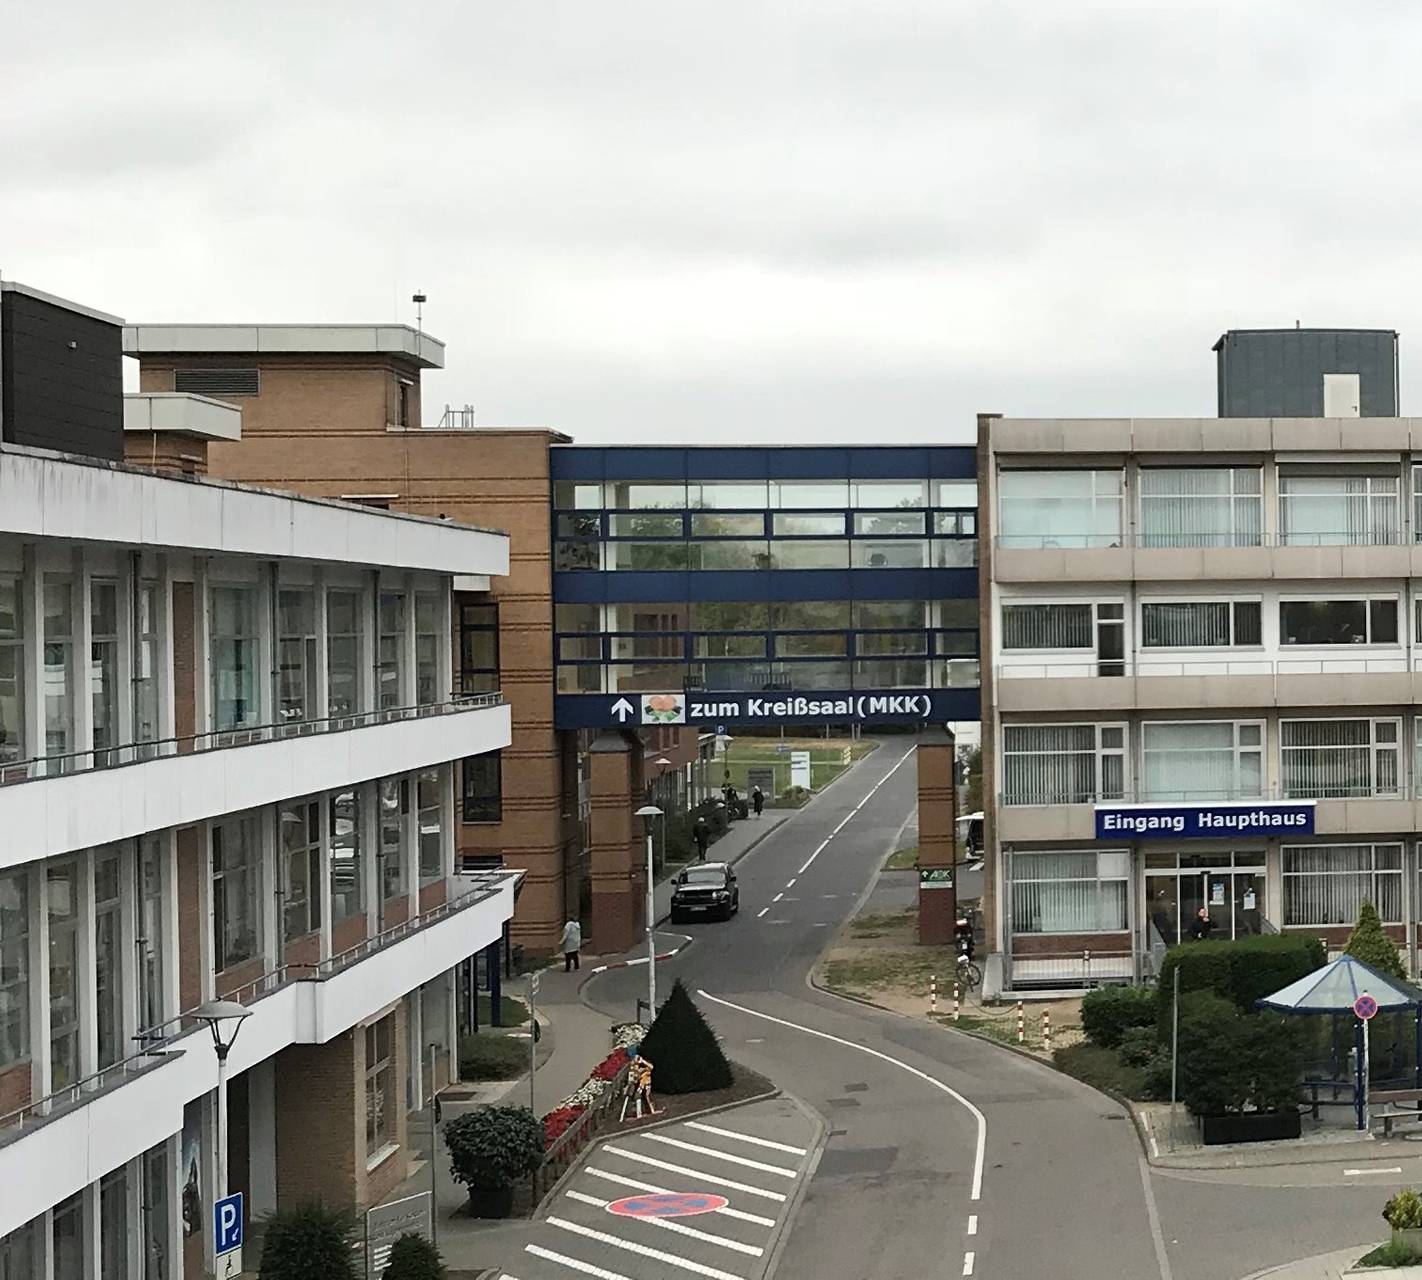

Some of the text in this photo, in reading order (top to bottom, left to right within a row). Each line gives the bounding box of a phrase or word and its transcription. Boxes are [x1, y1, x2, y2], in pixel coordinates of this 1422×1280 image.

[690, 702, 740, 717] zum
[718, 725, 724, 733] P
[1103, 811, 1307, 832] Eingang Haupthaus
[221, 1203, 236, 1246] P
